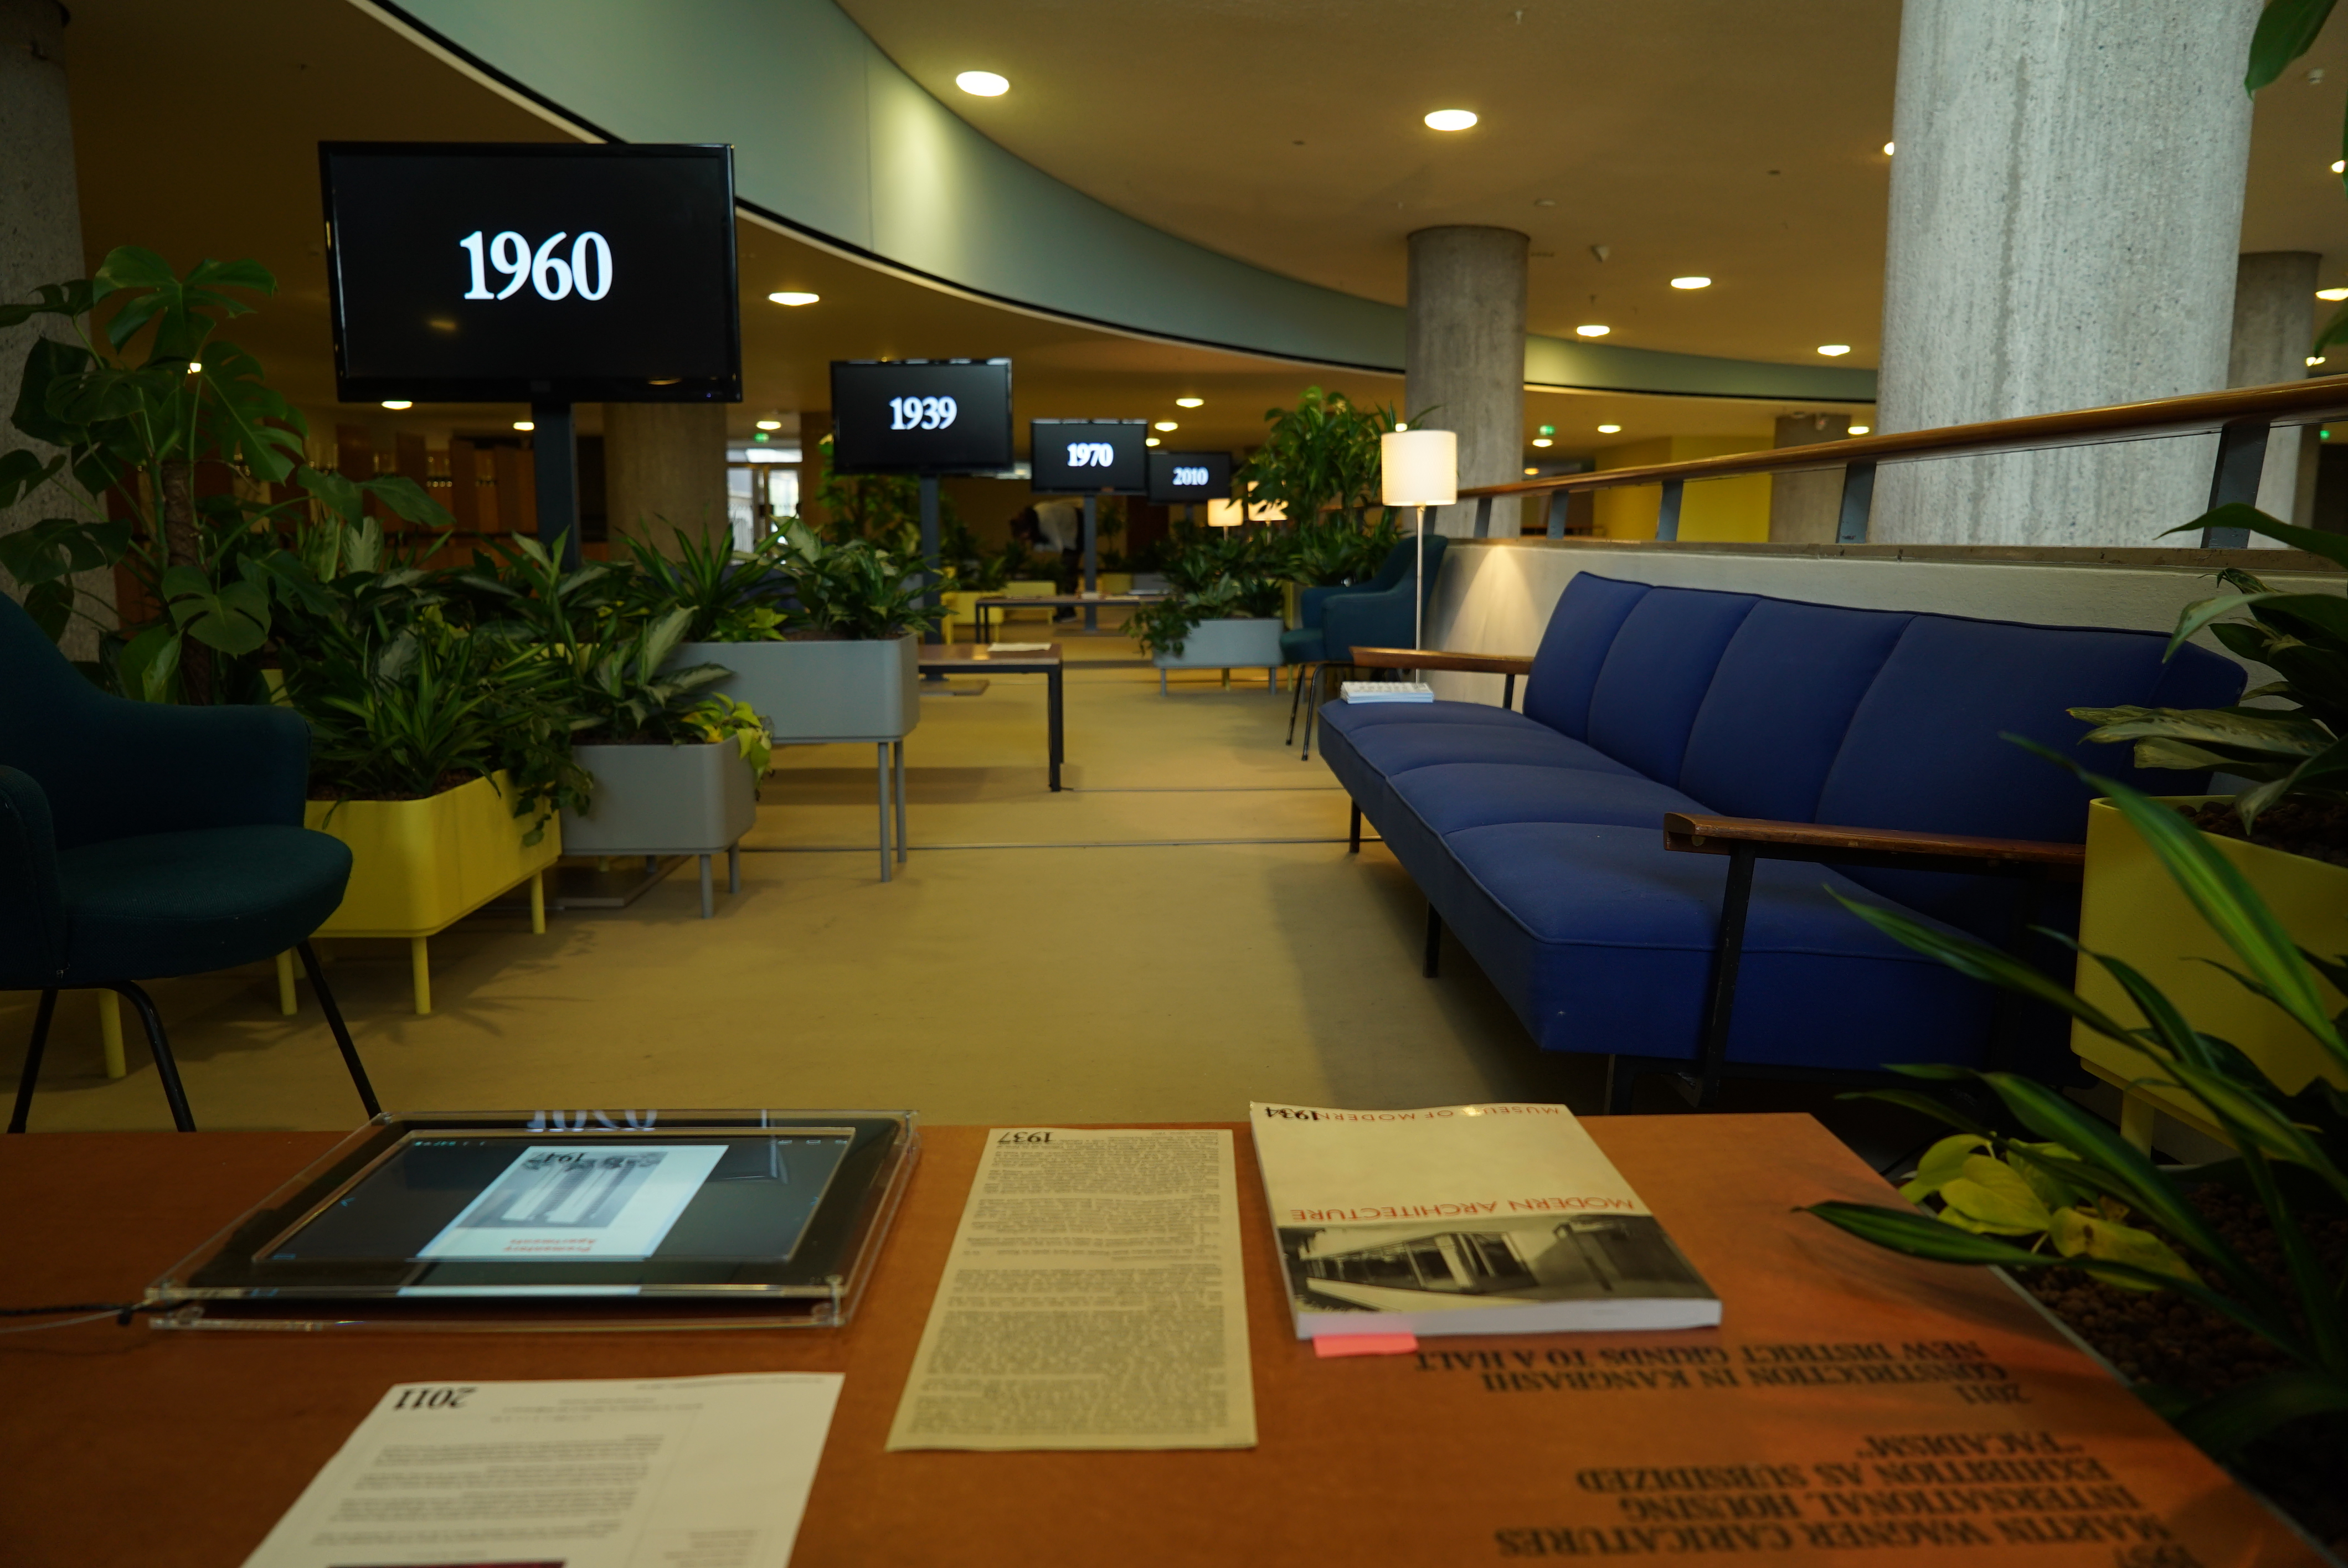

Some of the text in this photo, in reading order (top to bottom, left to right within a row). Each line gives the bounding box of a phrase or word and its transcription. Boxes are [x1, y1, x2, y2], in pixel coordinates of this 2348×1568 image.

[459, 230, 613, 301] 1960
[889, 396, 957, 430] 1939
[1067, 442, 1114, 467] 1970
[1172, 467, 1209, 486] 2010
[1264, 1107, 1320, 1122] 1934
[1314, 1112, 1415, 1122] MODERN
[1424, 1110, 1453, 1118] OF
[997, 1131, 1053, 1144] 1937
[528, 1152, 589, 1163] 1947
[1289, 1196, 1633, 1221] MODERN ARCHITECTURE
[1414, 1340, 1988, 1372] NEW DISTRICT GRINDS TO A HALT
[1480, 1363, 2008, 1394] CONSTRUCTION IN KANGBASHI
[393, 1387, 478, 1411] 2011
[1953, 1384, 2028, 1405] 2011
[1574, 1457, 2114, 1494] EXHIBITION AS SUBSIDIZED
[1618, 1485, 2141, 1523] INTERNATIONAL HOUSING
[1494, 1514, 2174, 1557] MARTIN WAGNER CARICATURES
